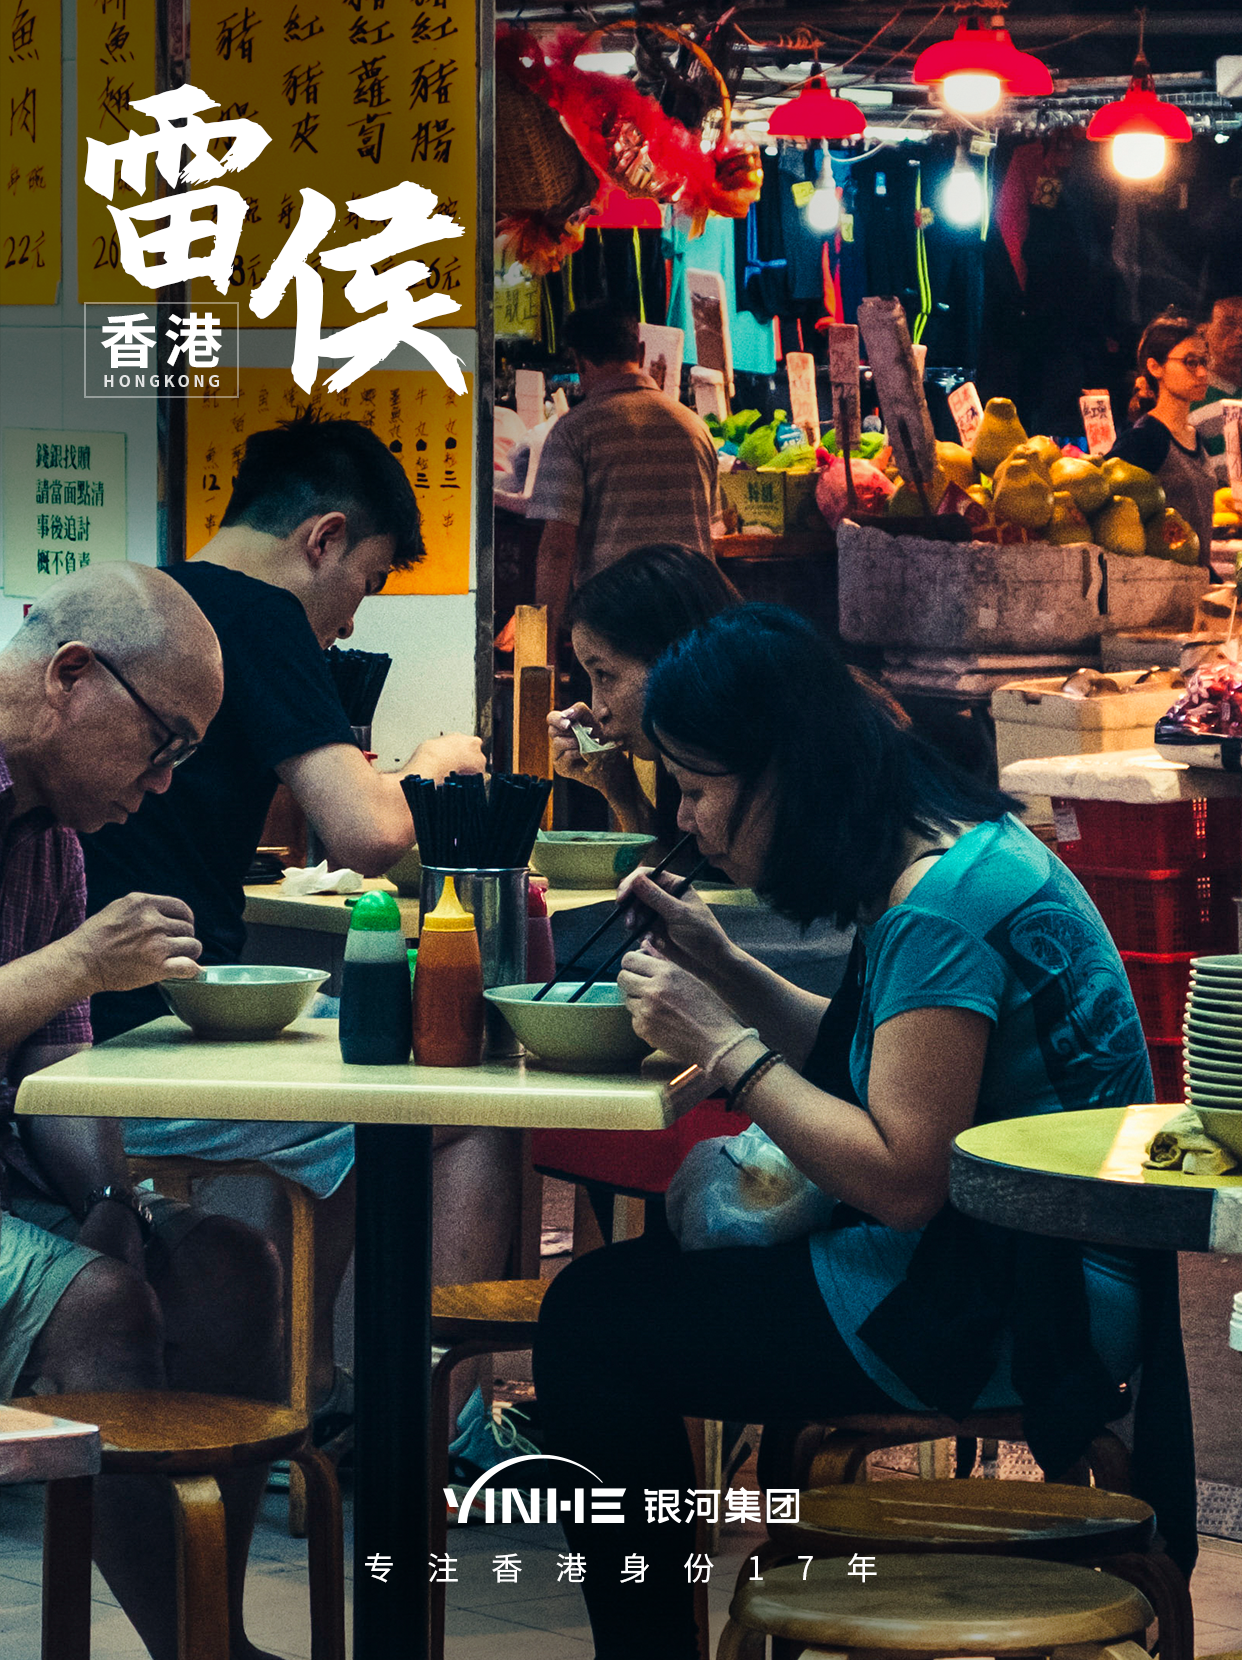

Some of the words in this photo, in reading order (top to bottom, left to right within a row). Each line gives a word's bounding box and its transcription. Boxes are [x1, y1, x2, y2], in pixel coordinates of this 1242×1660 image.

[8, 0, 39, 143] 魚肉
[36, 479, 104, 507] 請當面點清
[36, 514, 91, 542] 事後追討
